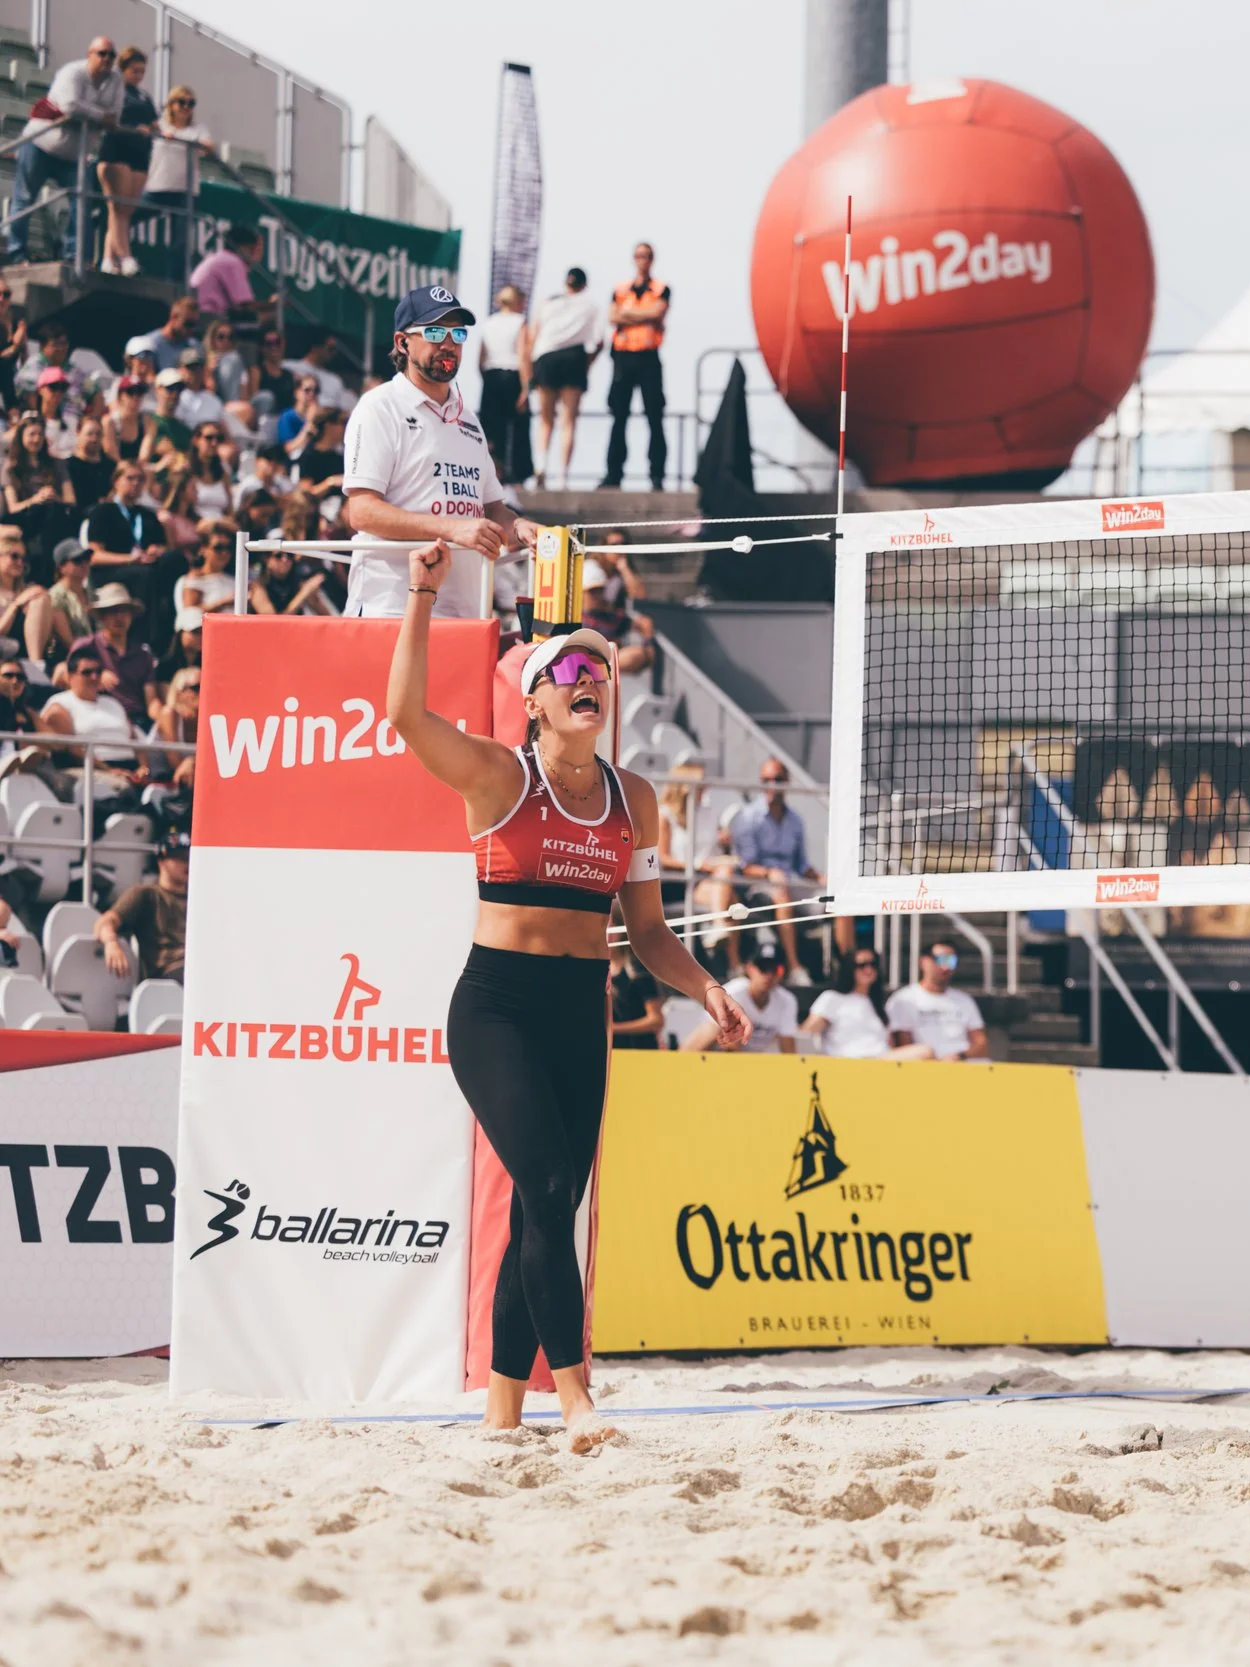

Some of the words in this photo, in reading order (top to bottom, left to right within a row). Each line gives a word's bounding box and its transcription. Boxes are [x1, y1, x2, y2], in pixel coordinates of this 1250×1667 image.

[821, 229, 1051, 322] win2day
[433, 462, 442, 477] 2
[444, 462, 480, 481] TEAMS
[443, 481, 449, 496] 1
[452, 482, 479, 499] BALL
[1106, 505, 1161, 529] win2day
[209, 697, 466, 778] win2d
[540, 806, 548, 821] 1
[545, 861, 612, 884] win2day
[1101, 877, 1156, 900] win2day
[840, 1184, 885, 1202] 1837
[250, 1204, 450, 1248] ballarina
[322, 1248, 370, 1263] beach
[372, 1249, 440, 1265] volleyball
[676, 1203, 972, 1302] Ottakringer
[749, 1316, 851, 1332] BRAUEREI
[878, 1315, 932, 1330] WIEN
